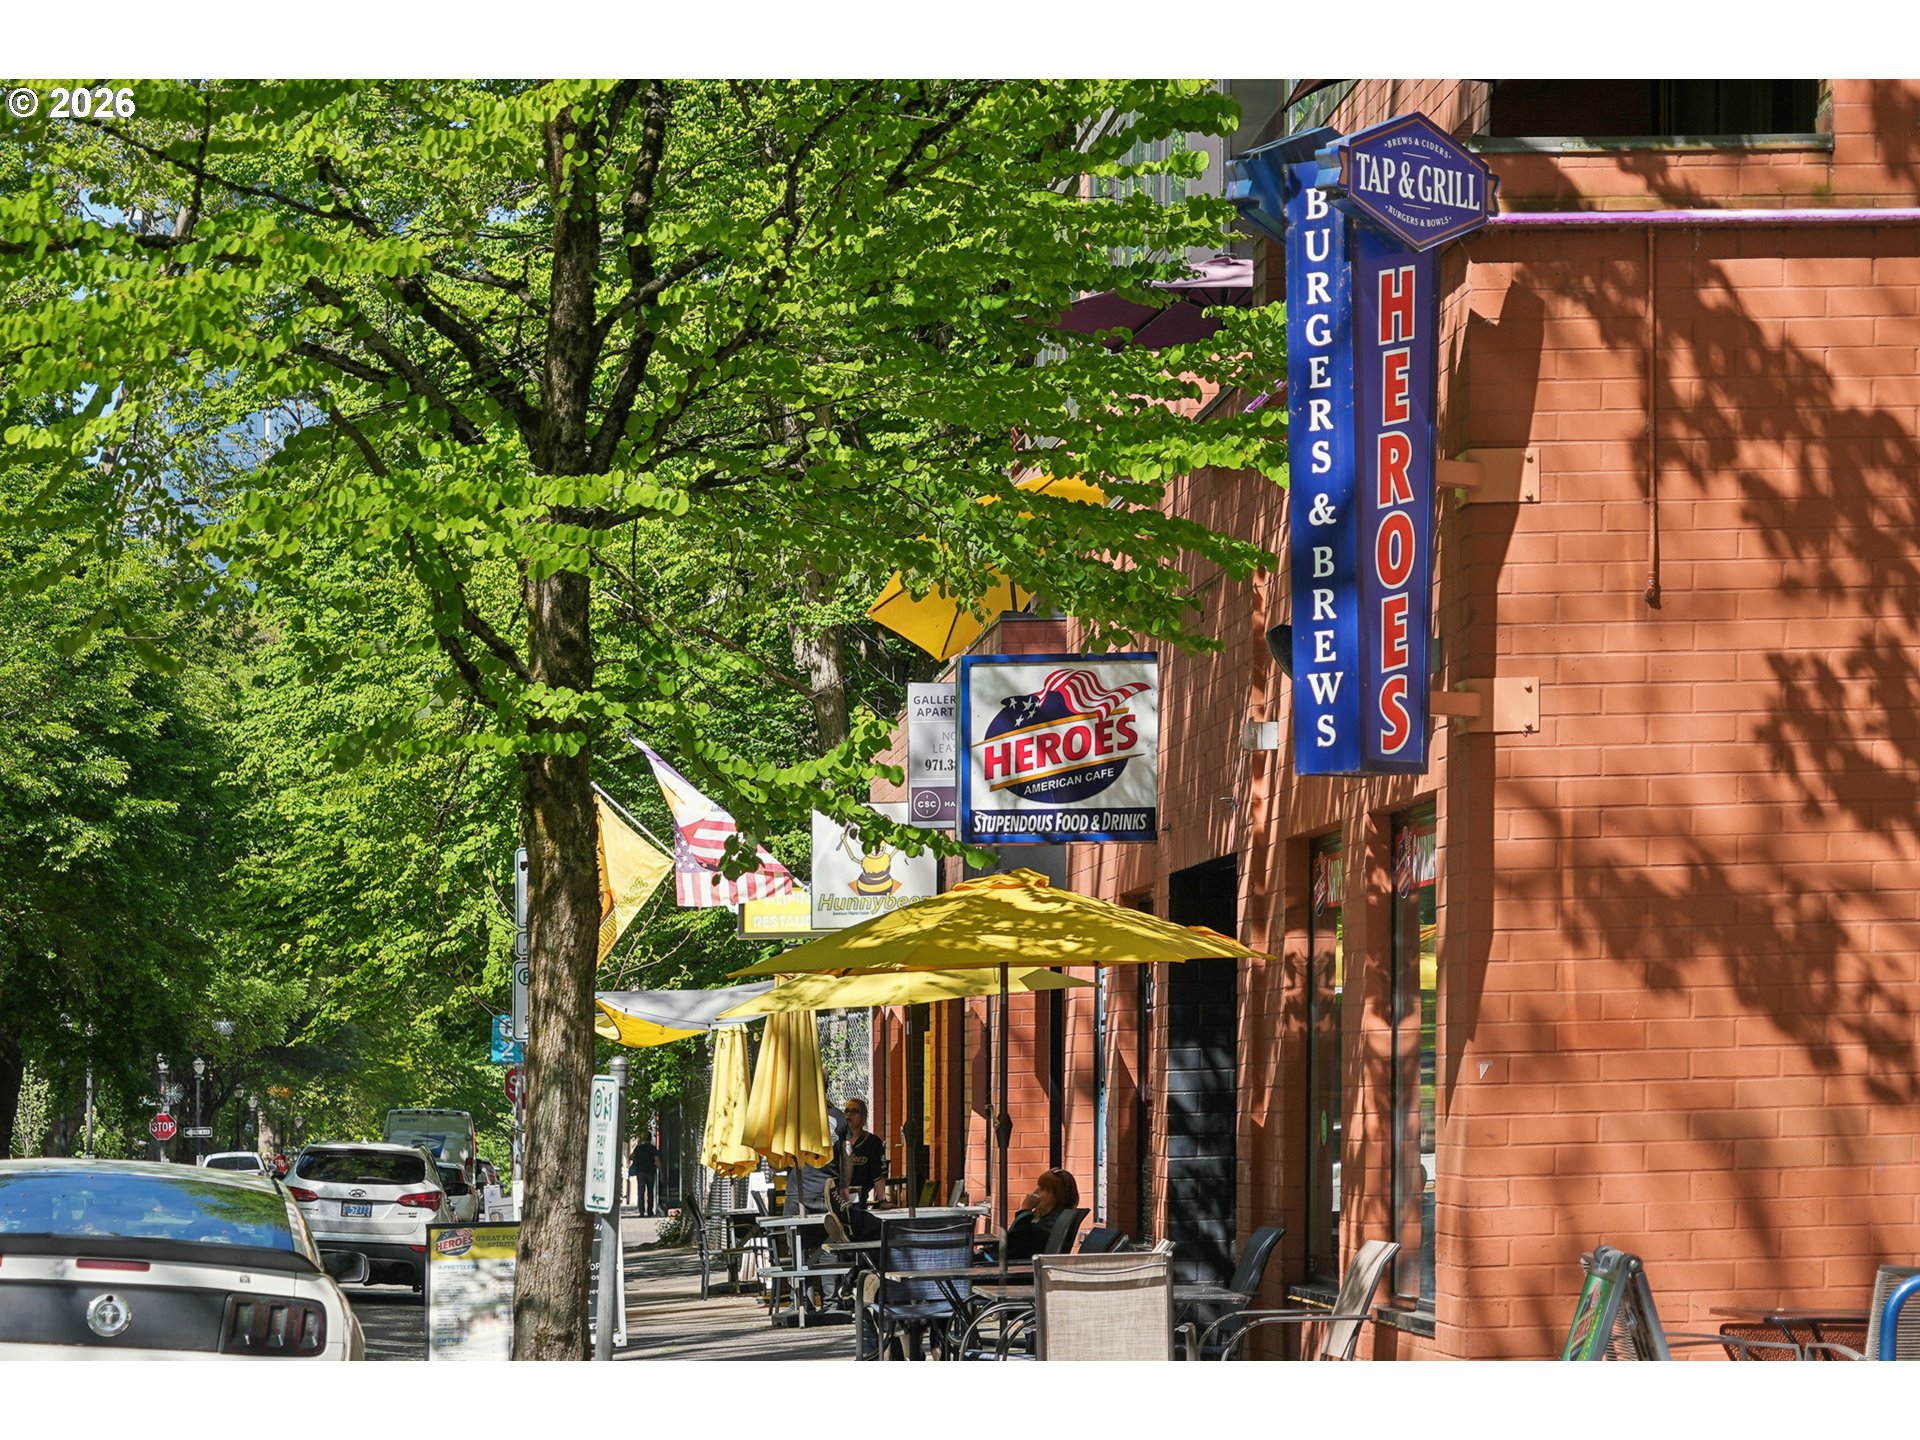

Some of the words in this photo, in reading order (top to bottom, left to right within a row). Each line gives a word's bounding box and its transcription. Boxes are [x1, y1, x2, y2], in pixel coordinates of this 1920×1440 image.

[1387, 137, 1413, 148] BREWS
[1414, 138, 1420, 146] &
[1421, 140, 1449, 159] CIDERS
[1356, 152, 1396, 195] TAP
[1399, 161, 1415, 199] &
[1418, 165, 1480, 211] GRILL
[1388, 204, 1419, 226] BURGERS
[1420, 219, 1425, 227] &
[1426, 216, 1449, 227] BOWLS
[1304, 188, 1333, 474] BURGERS
[1308, 493, 1337, 526] &
[1375, 264, 1416, 755] HEROES
[1307, 545, 1344, 747] BREWS
[916, 707, 954, 717] APART
[984, 714, 1138, 780] HEROES
[925, 759, 956, 771] 971.3
[1023, 775, 1082, 796] AMERICAN
[1085, 767, 1115, 782] CAFE
[917, 800, 937, 808] CSC
[973, 811, 1053, 833] STUPENDOUS
[1056, 812, 1088, 832] FOOD
[1090, 815, 1100, 831] &
[1102, 812, 1147, 831] DRINKS
[151, 1121, 175, 1132] STOP
[596, 1134, 606, 1149] PAY
[597, 1151, 605, 1166] TO
[592, 1168, 607, 1184] PARK
[435, 1235, 474, 1252] HEROES
